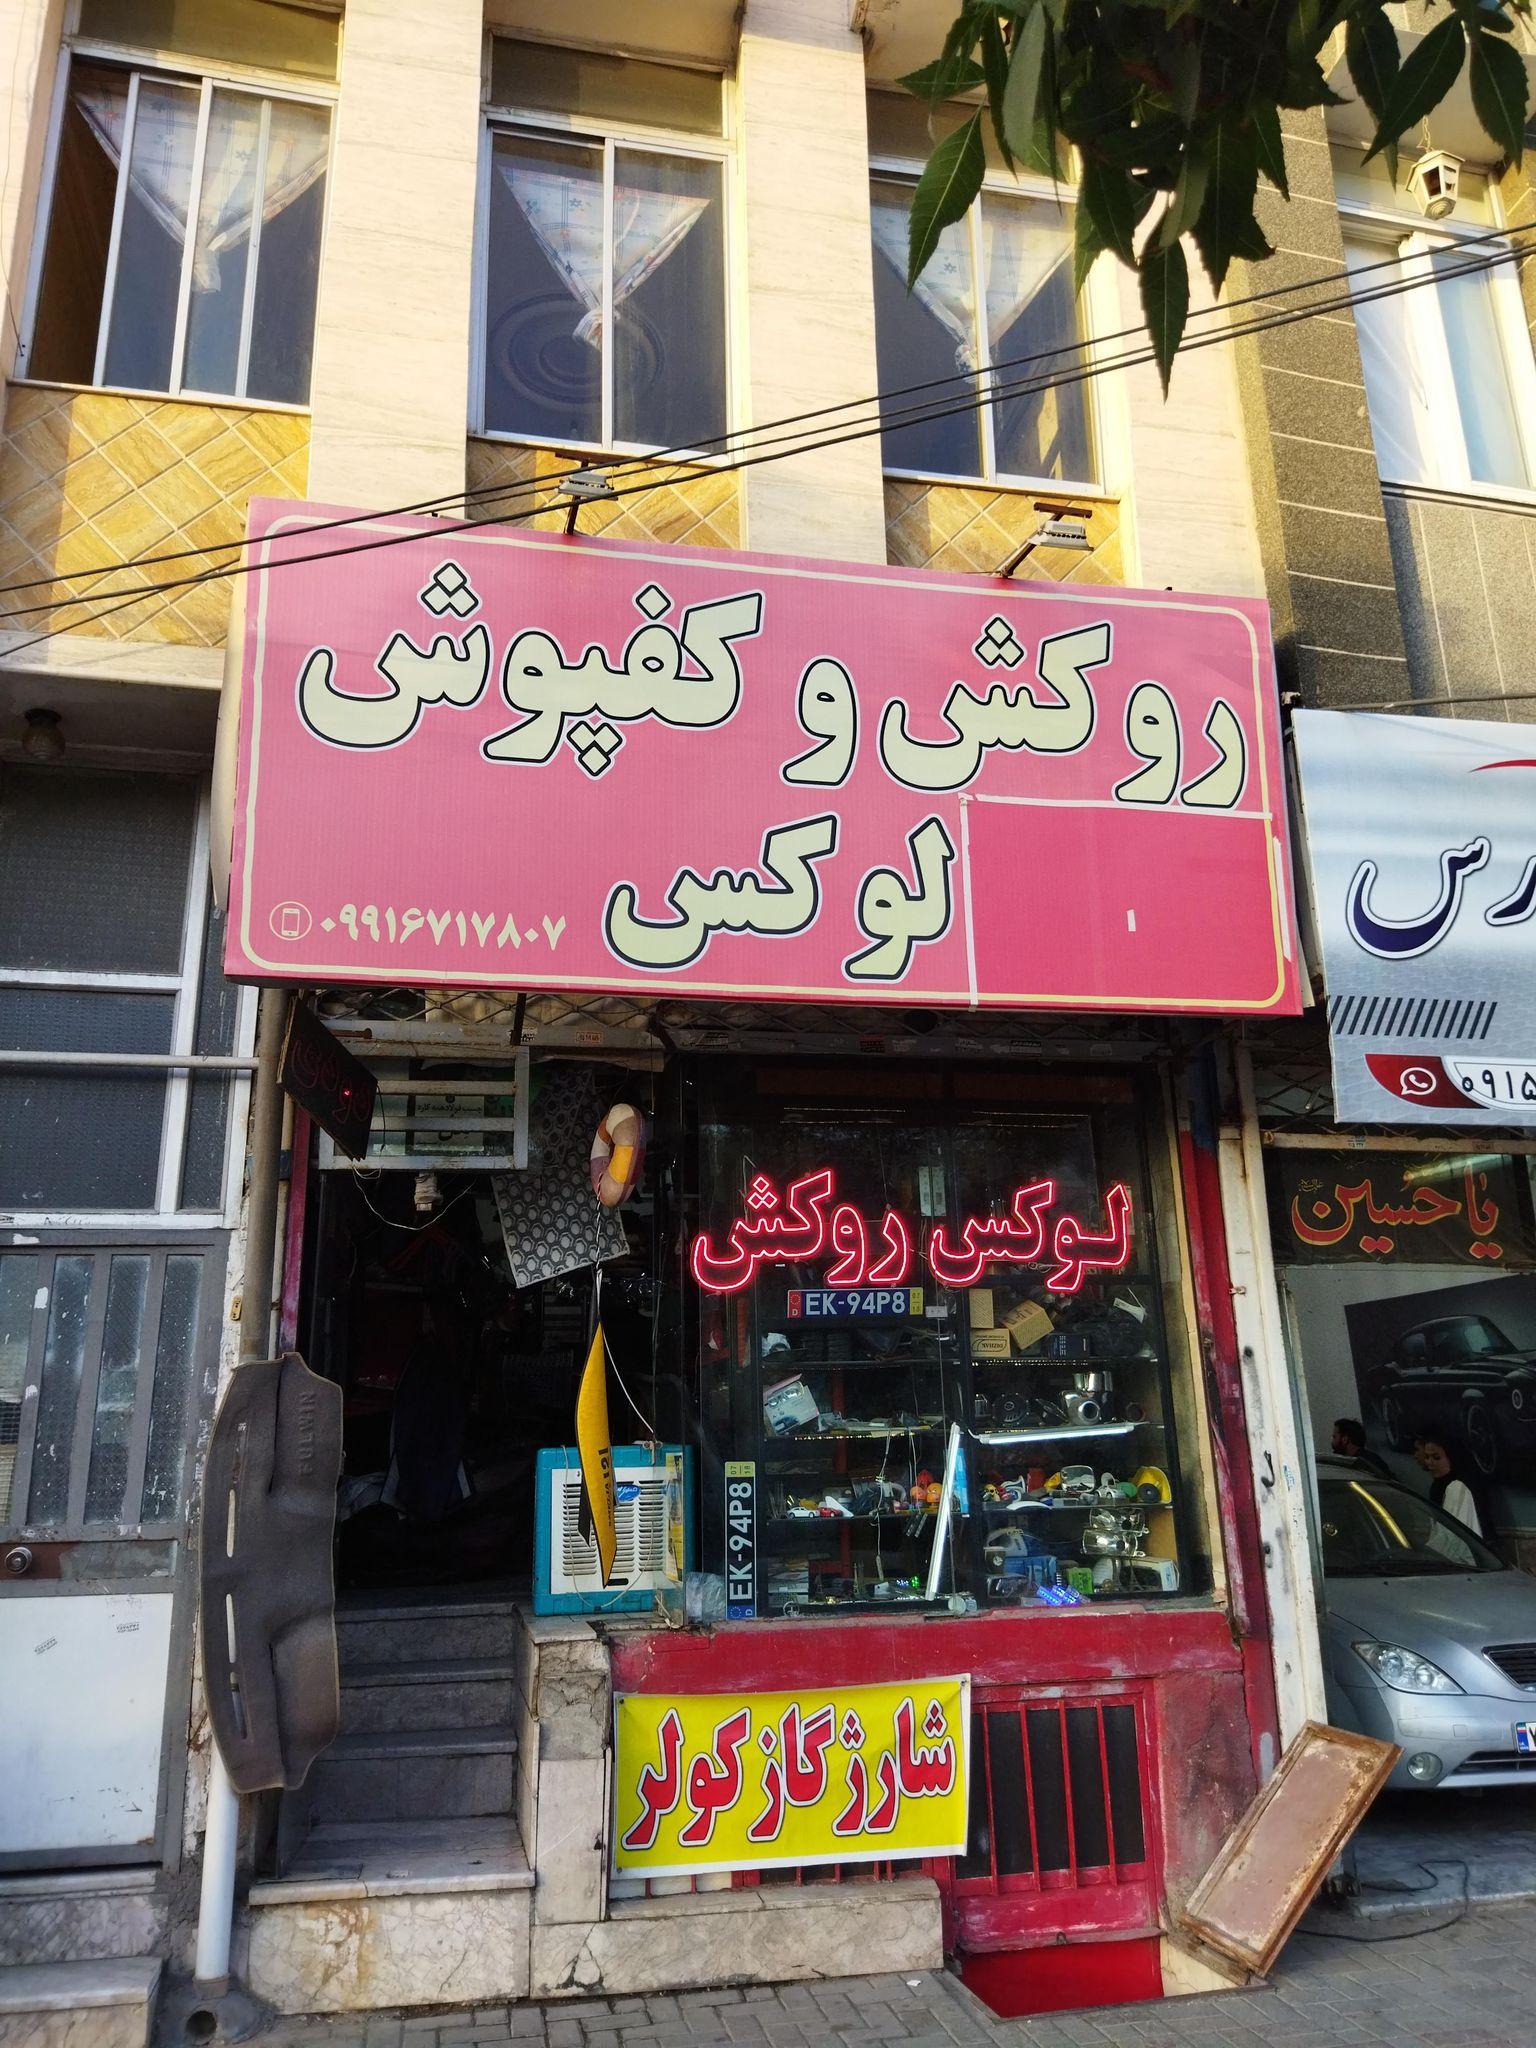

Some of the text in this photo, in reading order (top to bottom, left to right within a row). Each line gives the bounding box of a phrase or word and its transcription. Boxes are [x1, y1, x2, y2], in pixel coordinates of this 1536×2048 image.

[296, 560, 1249, 808] روکش و کفپوش
[321, 903, 567, 950] ۰۹۹۱۶۷۱۷۸۰۷
[603, 812, 958, 982] لوکس
[692, 1169, 1131, 1292] لوکس روکش
[805, 1291, 906, 1316] EK-94P8
[729, 1482, 753, 1600] EK-94P8
[621, 1696, 956, 1850] شارژ گاز کولر
